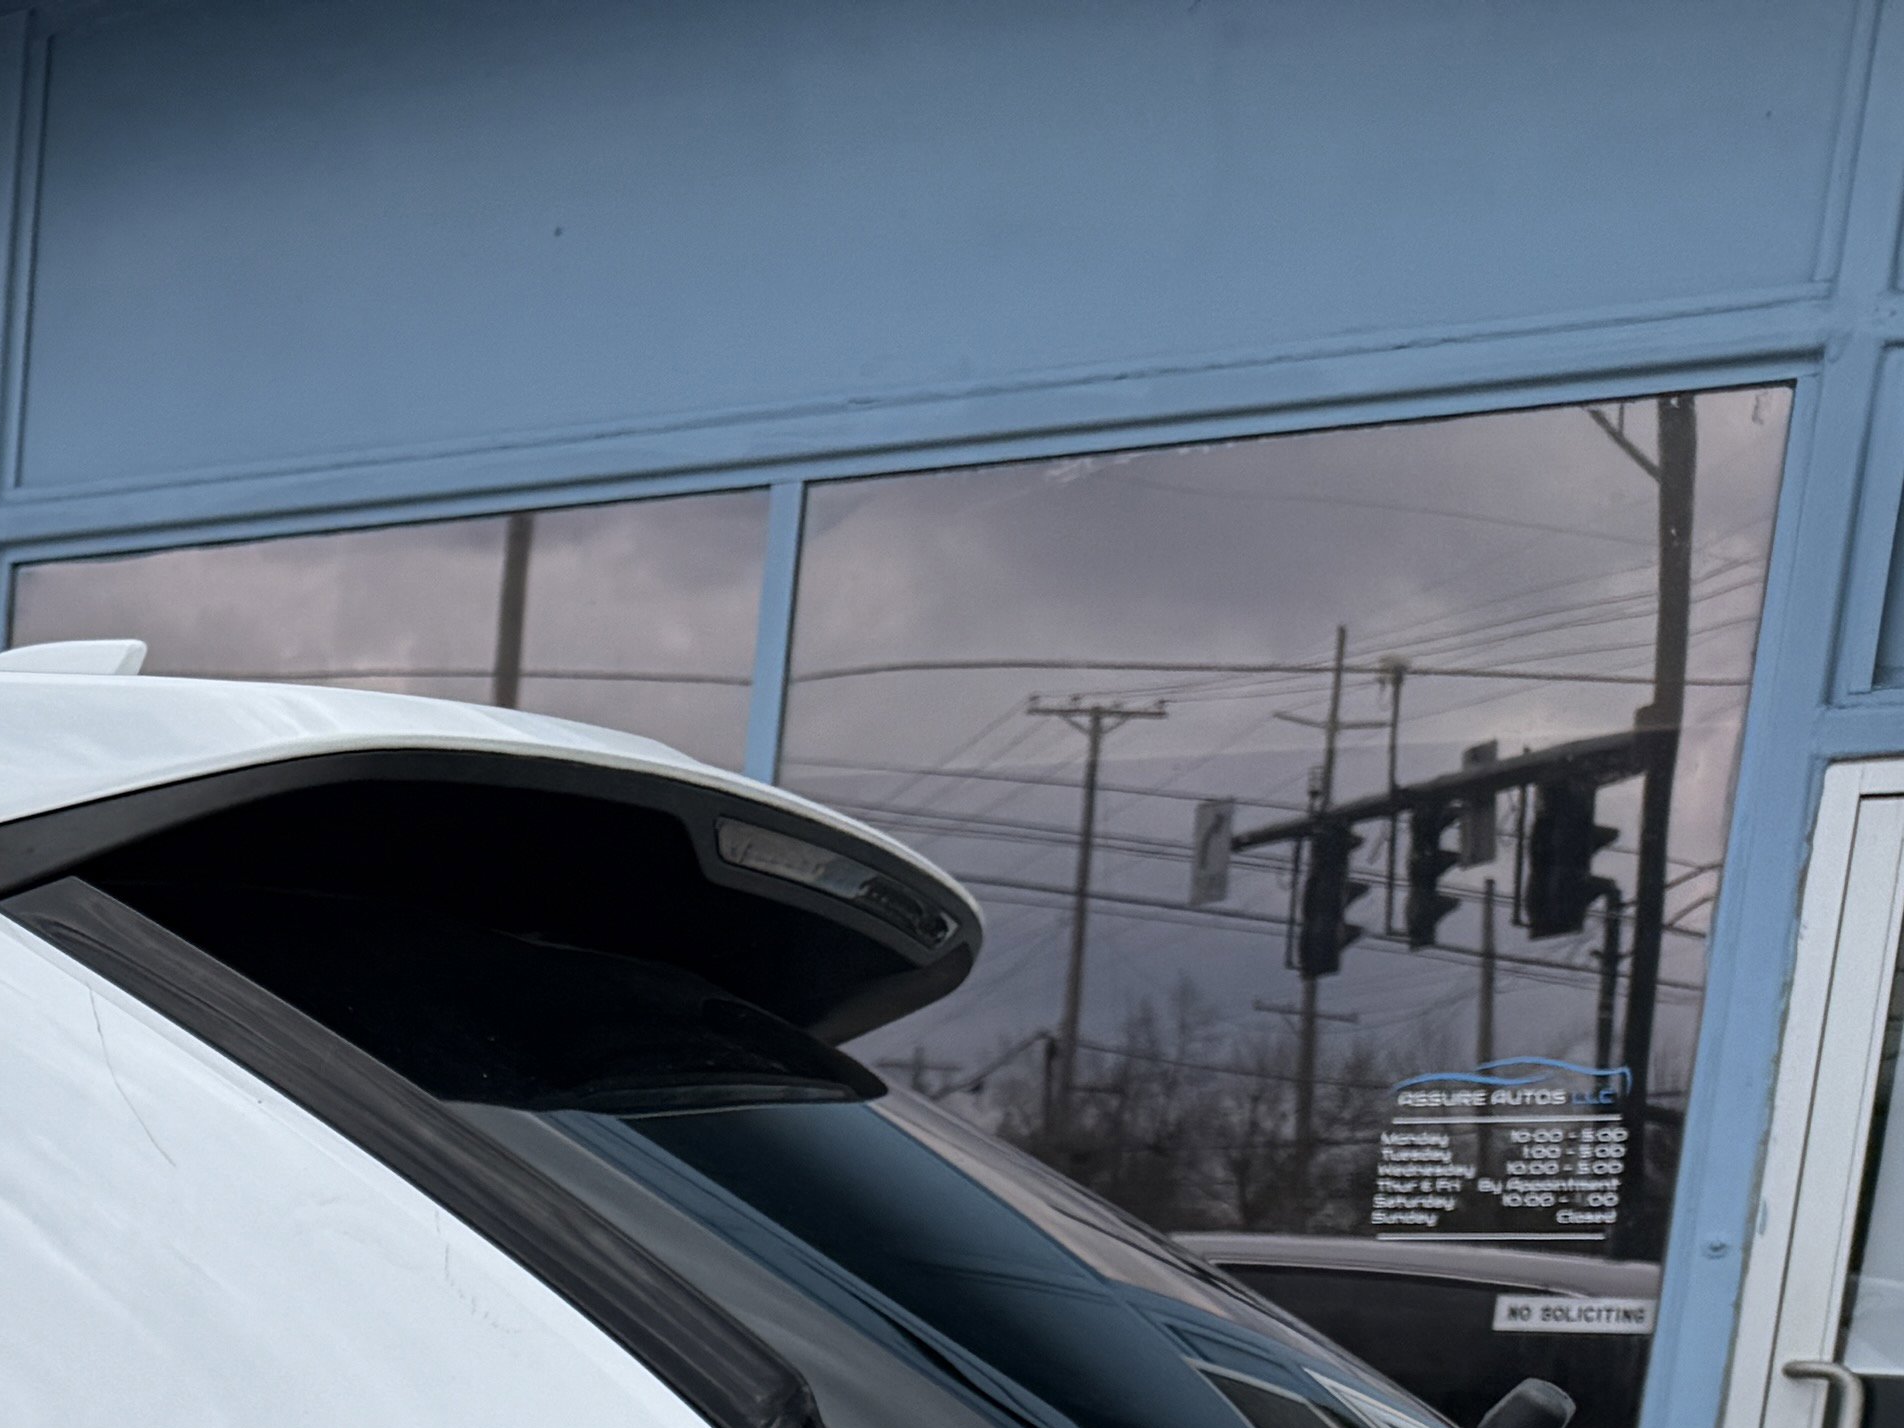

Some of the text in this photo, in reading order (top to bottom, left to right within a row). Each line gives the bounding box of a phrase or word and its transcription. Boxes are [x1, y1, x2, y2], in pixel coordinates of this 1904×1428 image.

[1397, 1089, 1614, 1106] ASSURE AUTOS LLC
[1380, 1131, 1450, 1148] Monday
[1382, 1147, 1452, 1164] Tuesday
[1377, 1162, 1476, 1180] Wednesday
[1477, 1177, 1503, 1195] By
[1372, 1193, 1456, 1211] Saturday
[1370, 1209, 1439, 1227] Sunday
[1506, 1305, 1645, 1324] NO SOLICITING
